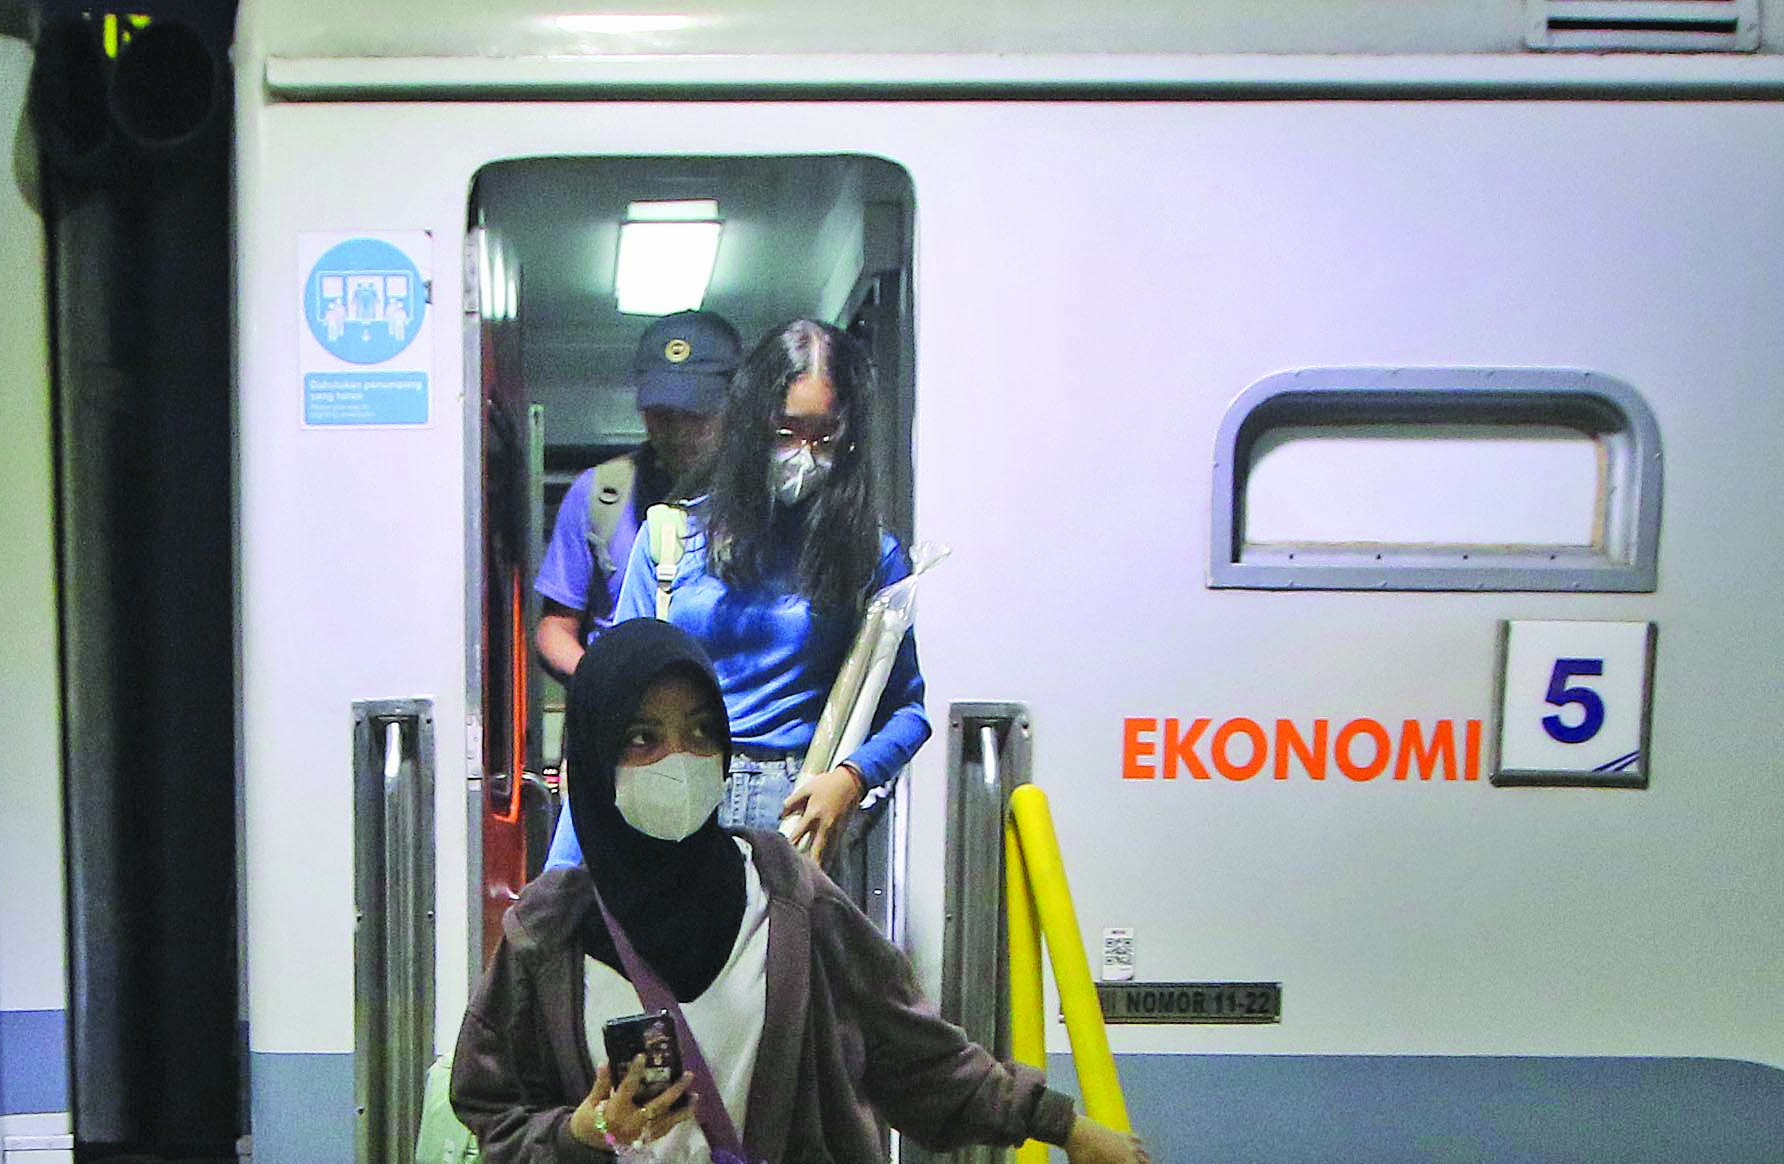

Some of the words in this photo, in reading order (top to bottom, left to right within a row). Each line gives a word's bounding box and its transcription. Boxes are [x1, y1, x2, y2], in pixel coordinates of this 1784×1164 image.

[1541, 658, 1605, 745] 5
[1122, 717, 1482, 782] EKONOMI
[1126, 989, 1207, 1014] NOMOR
[1215, 990, 1271, 1013] 11-22
